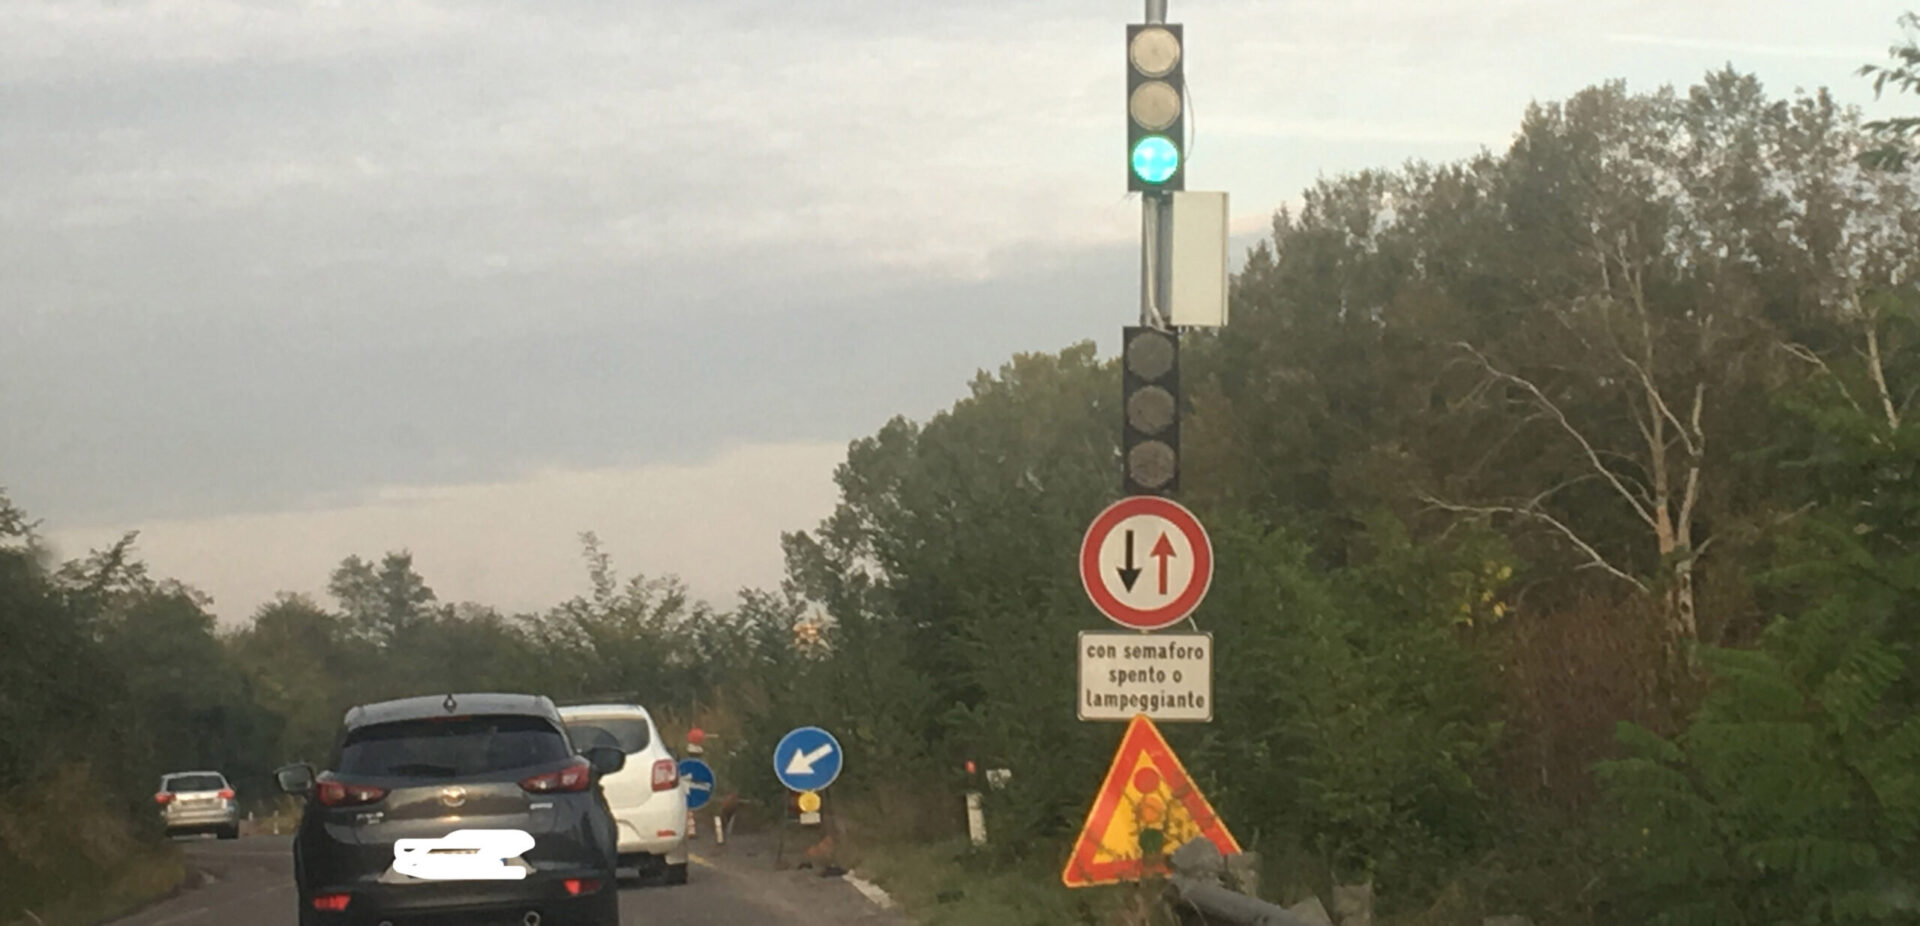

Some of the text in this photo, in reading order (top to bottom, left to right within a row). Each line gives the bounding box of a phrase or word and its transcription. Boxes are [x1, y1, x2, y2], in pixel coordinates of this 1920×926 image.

[1087, 641, 1204, 660] con semaforo
[1109, 666, 1182, 686] spento o
[1086, 689, 1205, 712] lampeggiante
